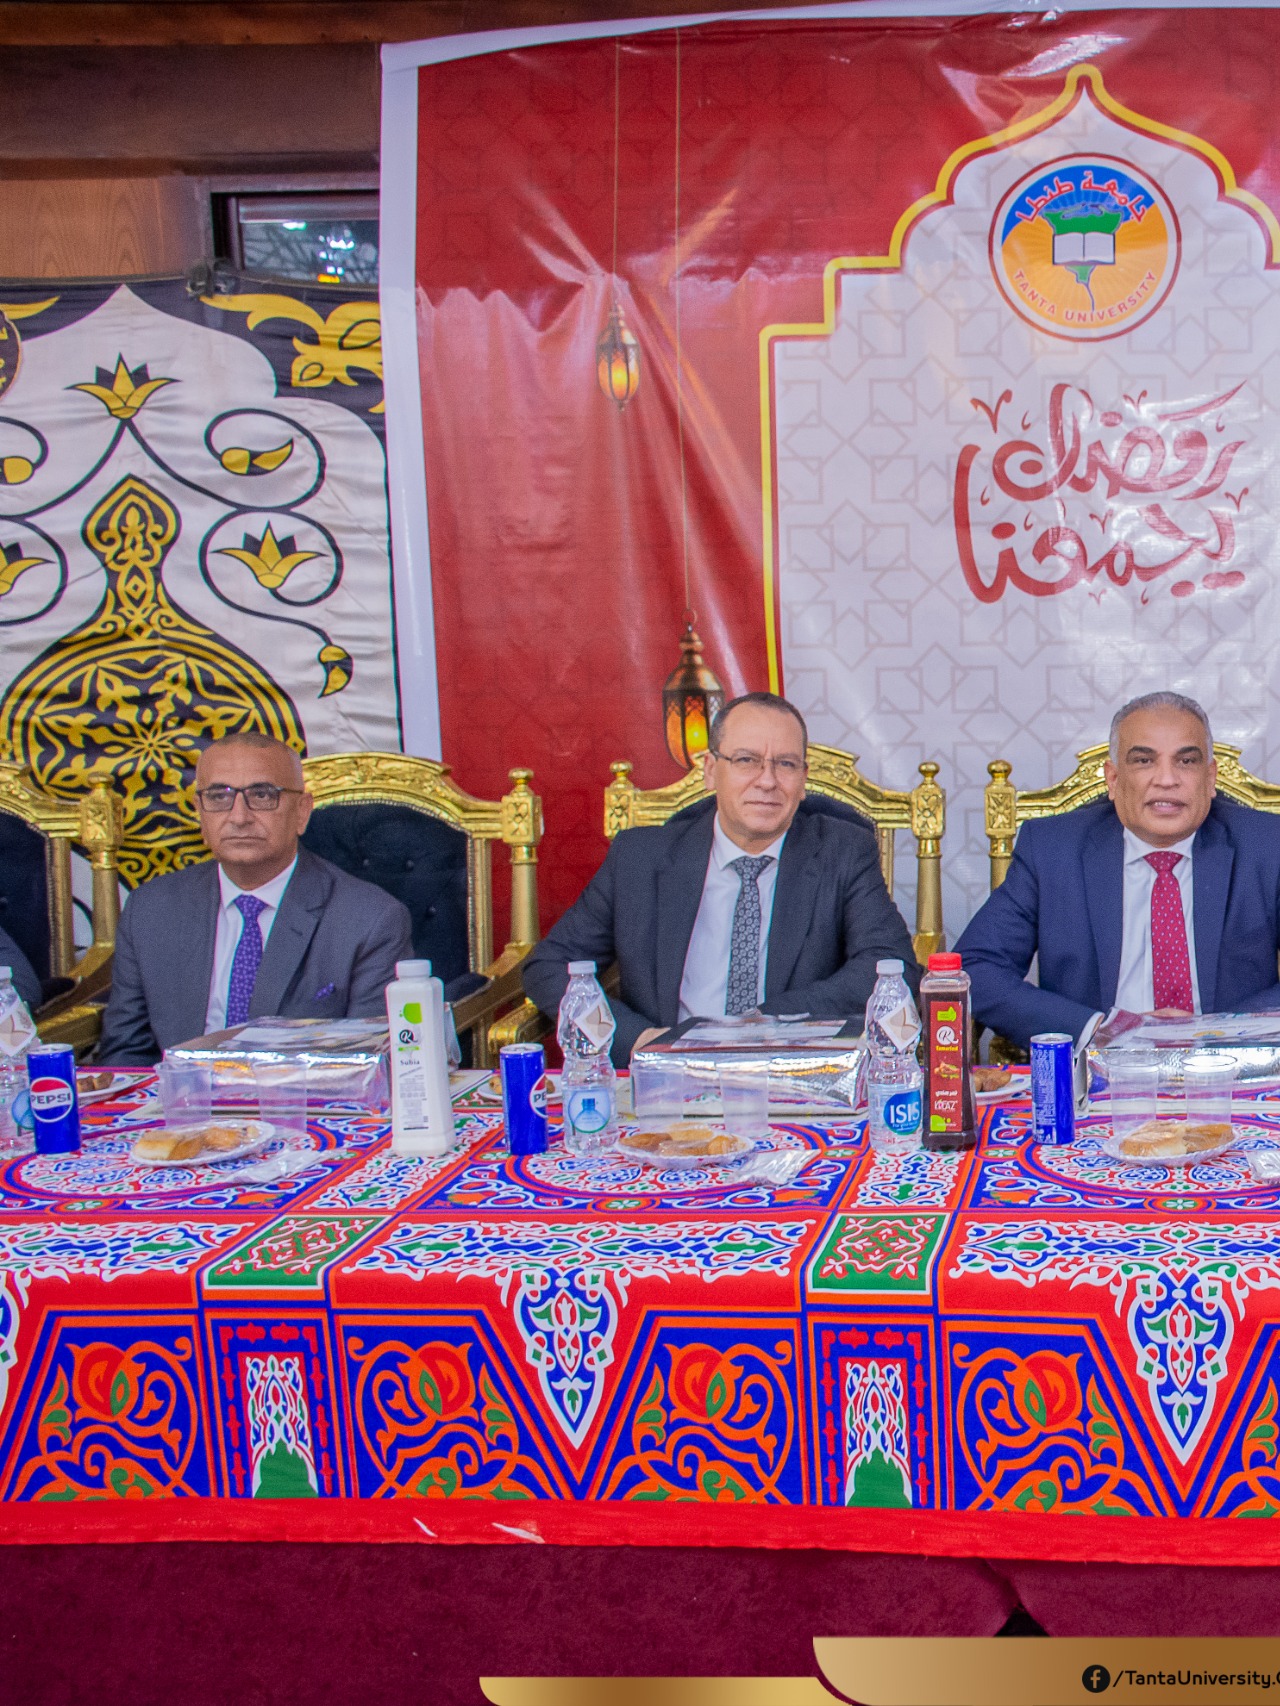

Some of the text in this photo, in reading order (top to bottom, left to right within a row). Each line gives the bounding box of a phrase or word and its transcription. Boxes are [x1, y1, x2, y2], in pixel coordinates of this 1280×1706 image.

[1015, 170, 1147, 223] جامعة طنطا
[1014, 270, 1156, 322] TANTA UNIVERSITY
[992, 379, 1248, 500] رمضان
[953, 443, 1246, 604] يجمعنا
[30, 1092, 71, 1104] PEPSI
[890, 1101, 920, 1124] ISIS
